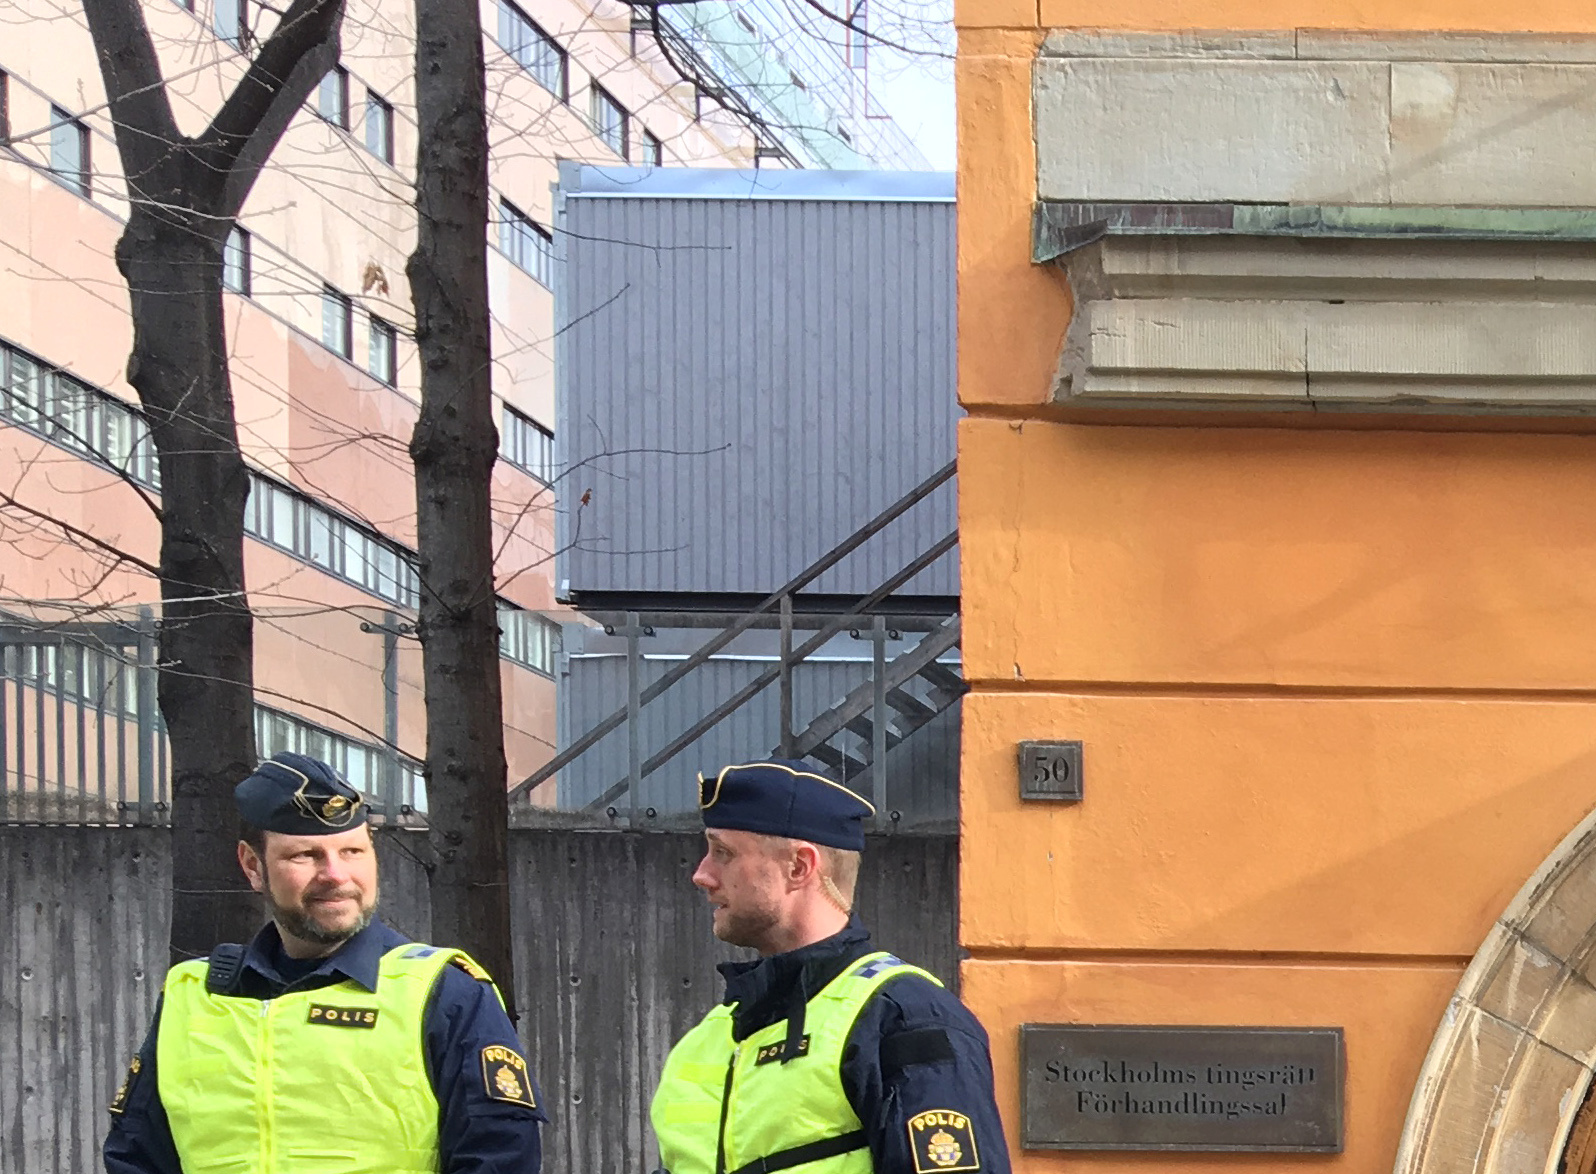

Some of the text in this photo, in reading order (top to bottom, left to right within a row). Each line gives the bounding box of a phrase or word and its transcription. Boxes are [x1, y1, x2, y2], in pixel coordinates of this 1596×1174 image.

[1034, 756, 1069, 783] 50
[311, 1008, 374, 1022] POLIS
[486, 1049, 523, 1069] POLIS
[1045, 1060, 1197, 1084] Stockholms
[1077, 1091, 1286, 1120] Förhandlingssal
[913, 1113, 966, 1131] POLIS
